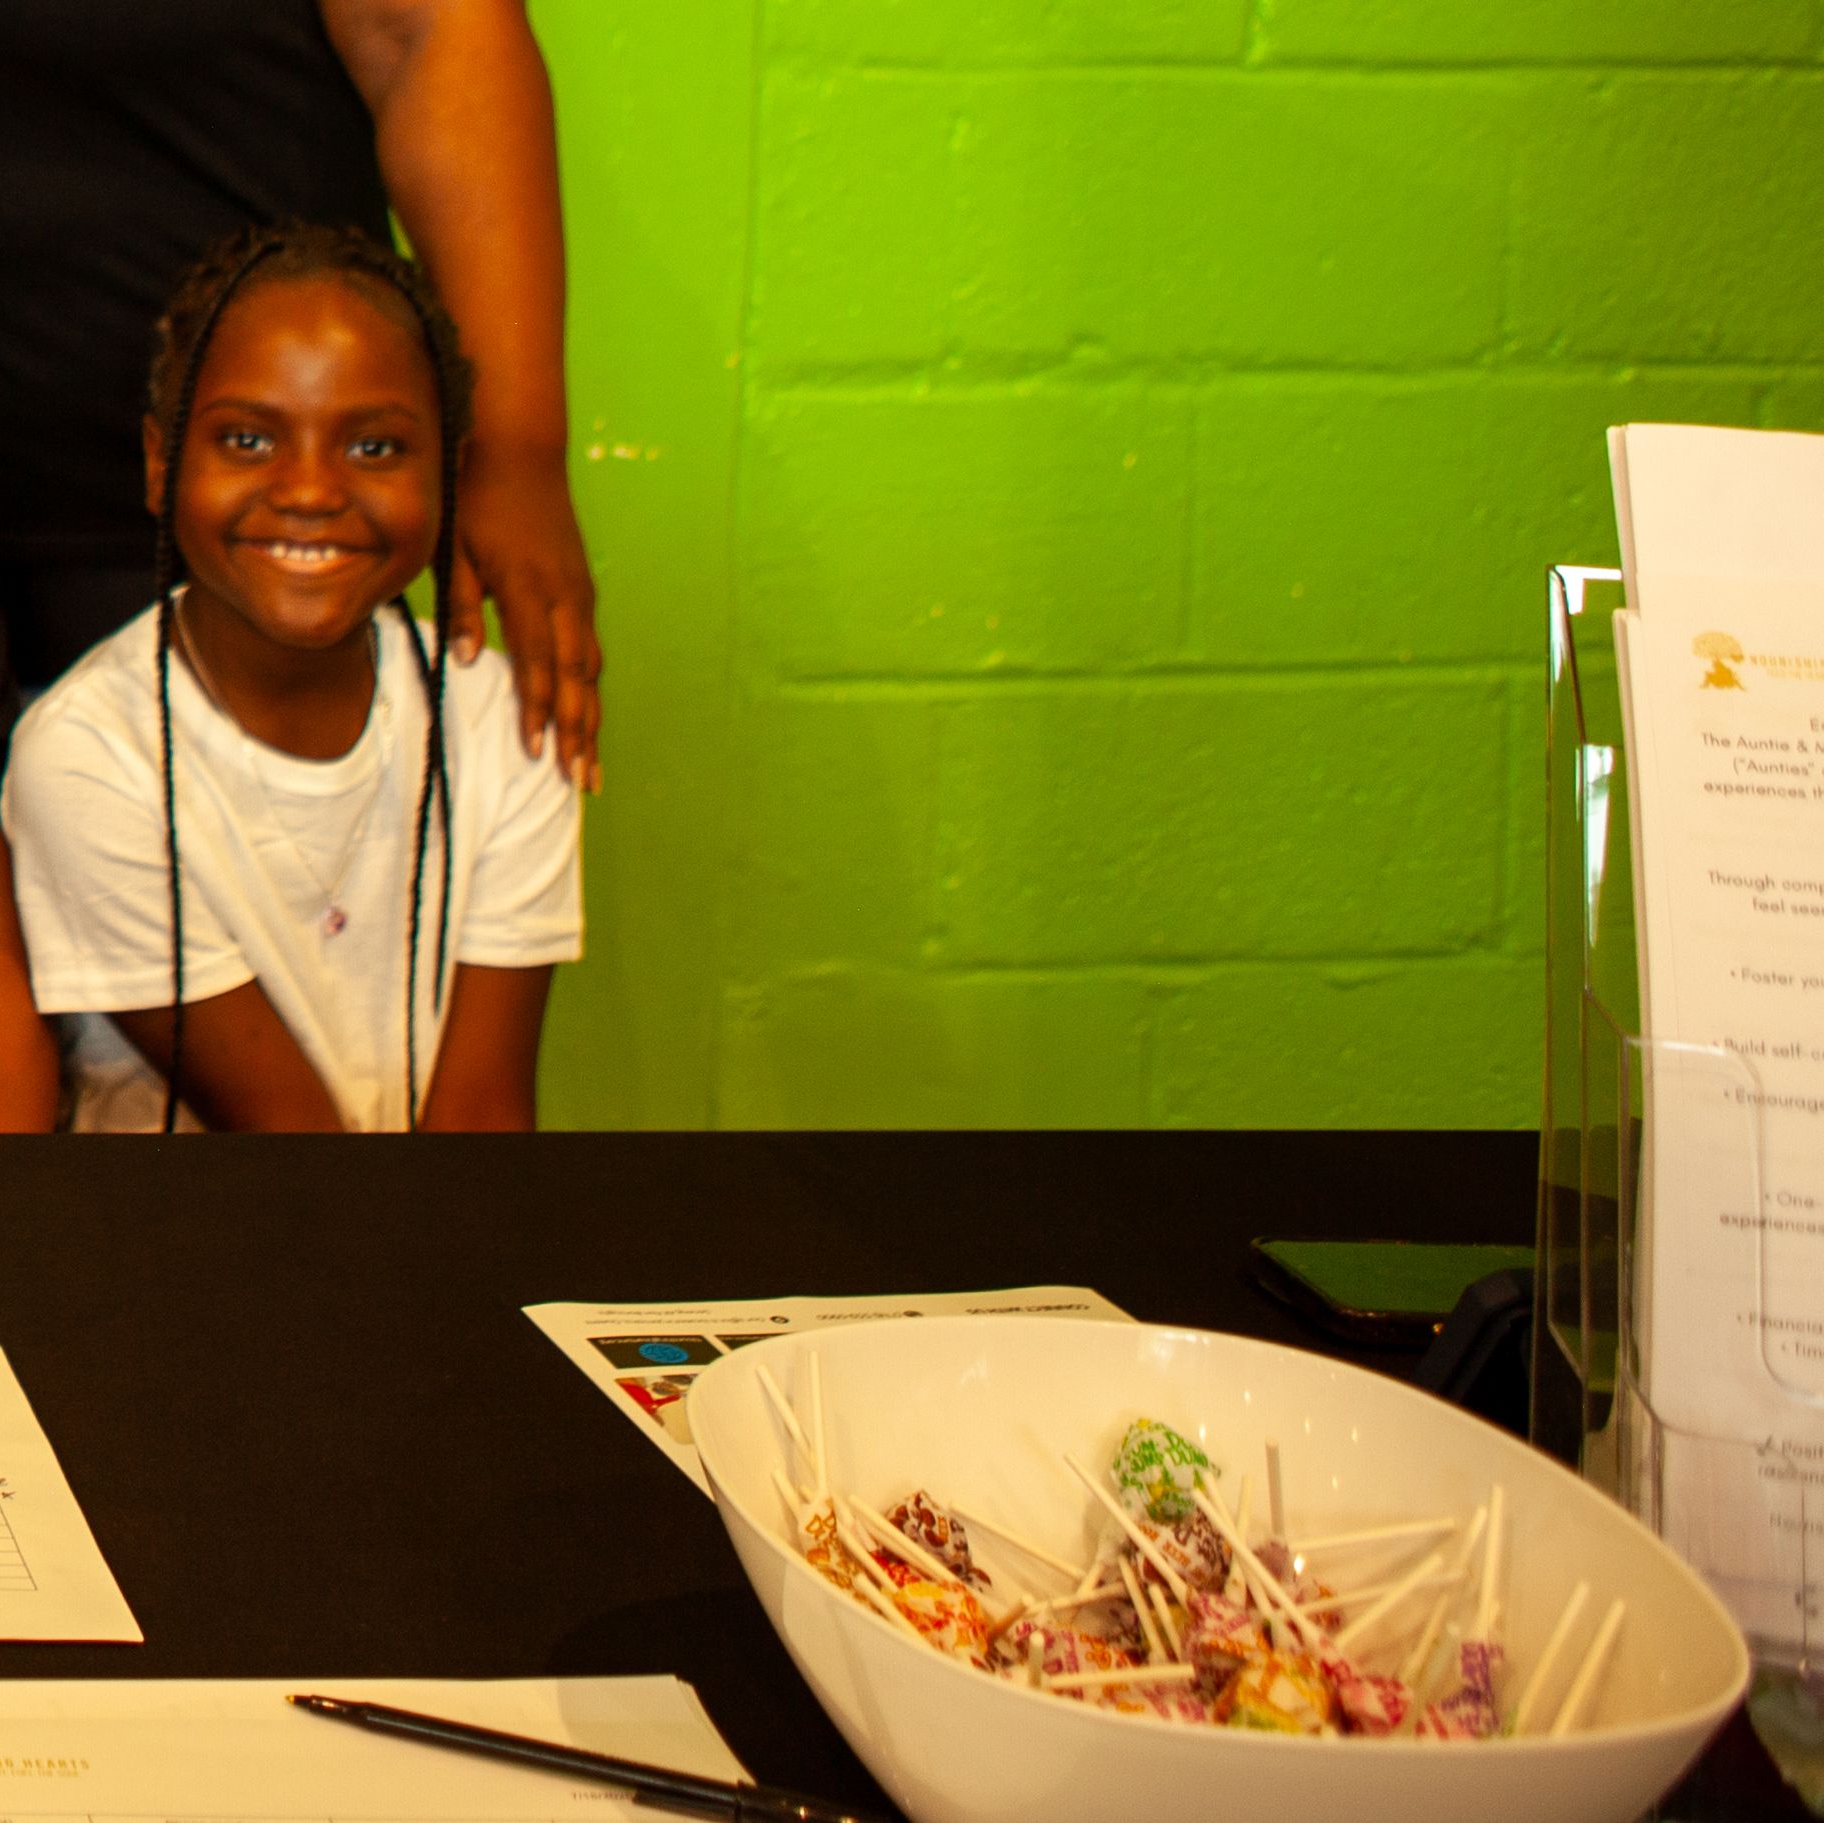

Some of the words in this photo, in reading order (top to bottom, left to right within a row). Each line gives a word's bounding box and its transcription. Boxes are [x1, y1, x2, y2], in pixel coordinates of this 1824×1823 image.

[1702, 731, 1732, 749] The
[1737, 735, 1791, 753] Auntie
[1796, 739, 1809, 754] &
[1703, 780, 1807, 800] experiences
[1707, 869, 1776, 893] Through
[1752, 896, 1785, 913] feel
[22, 1758, 90, 1771] HEARTS
